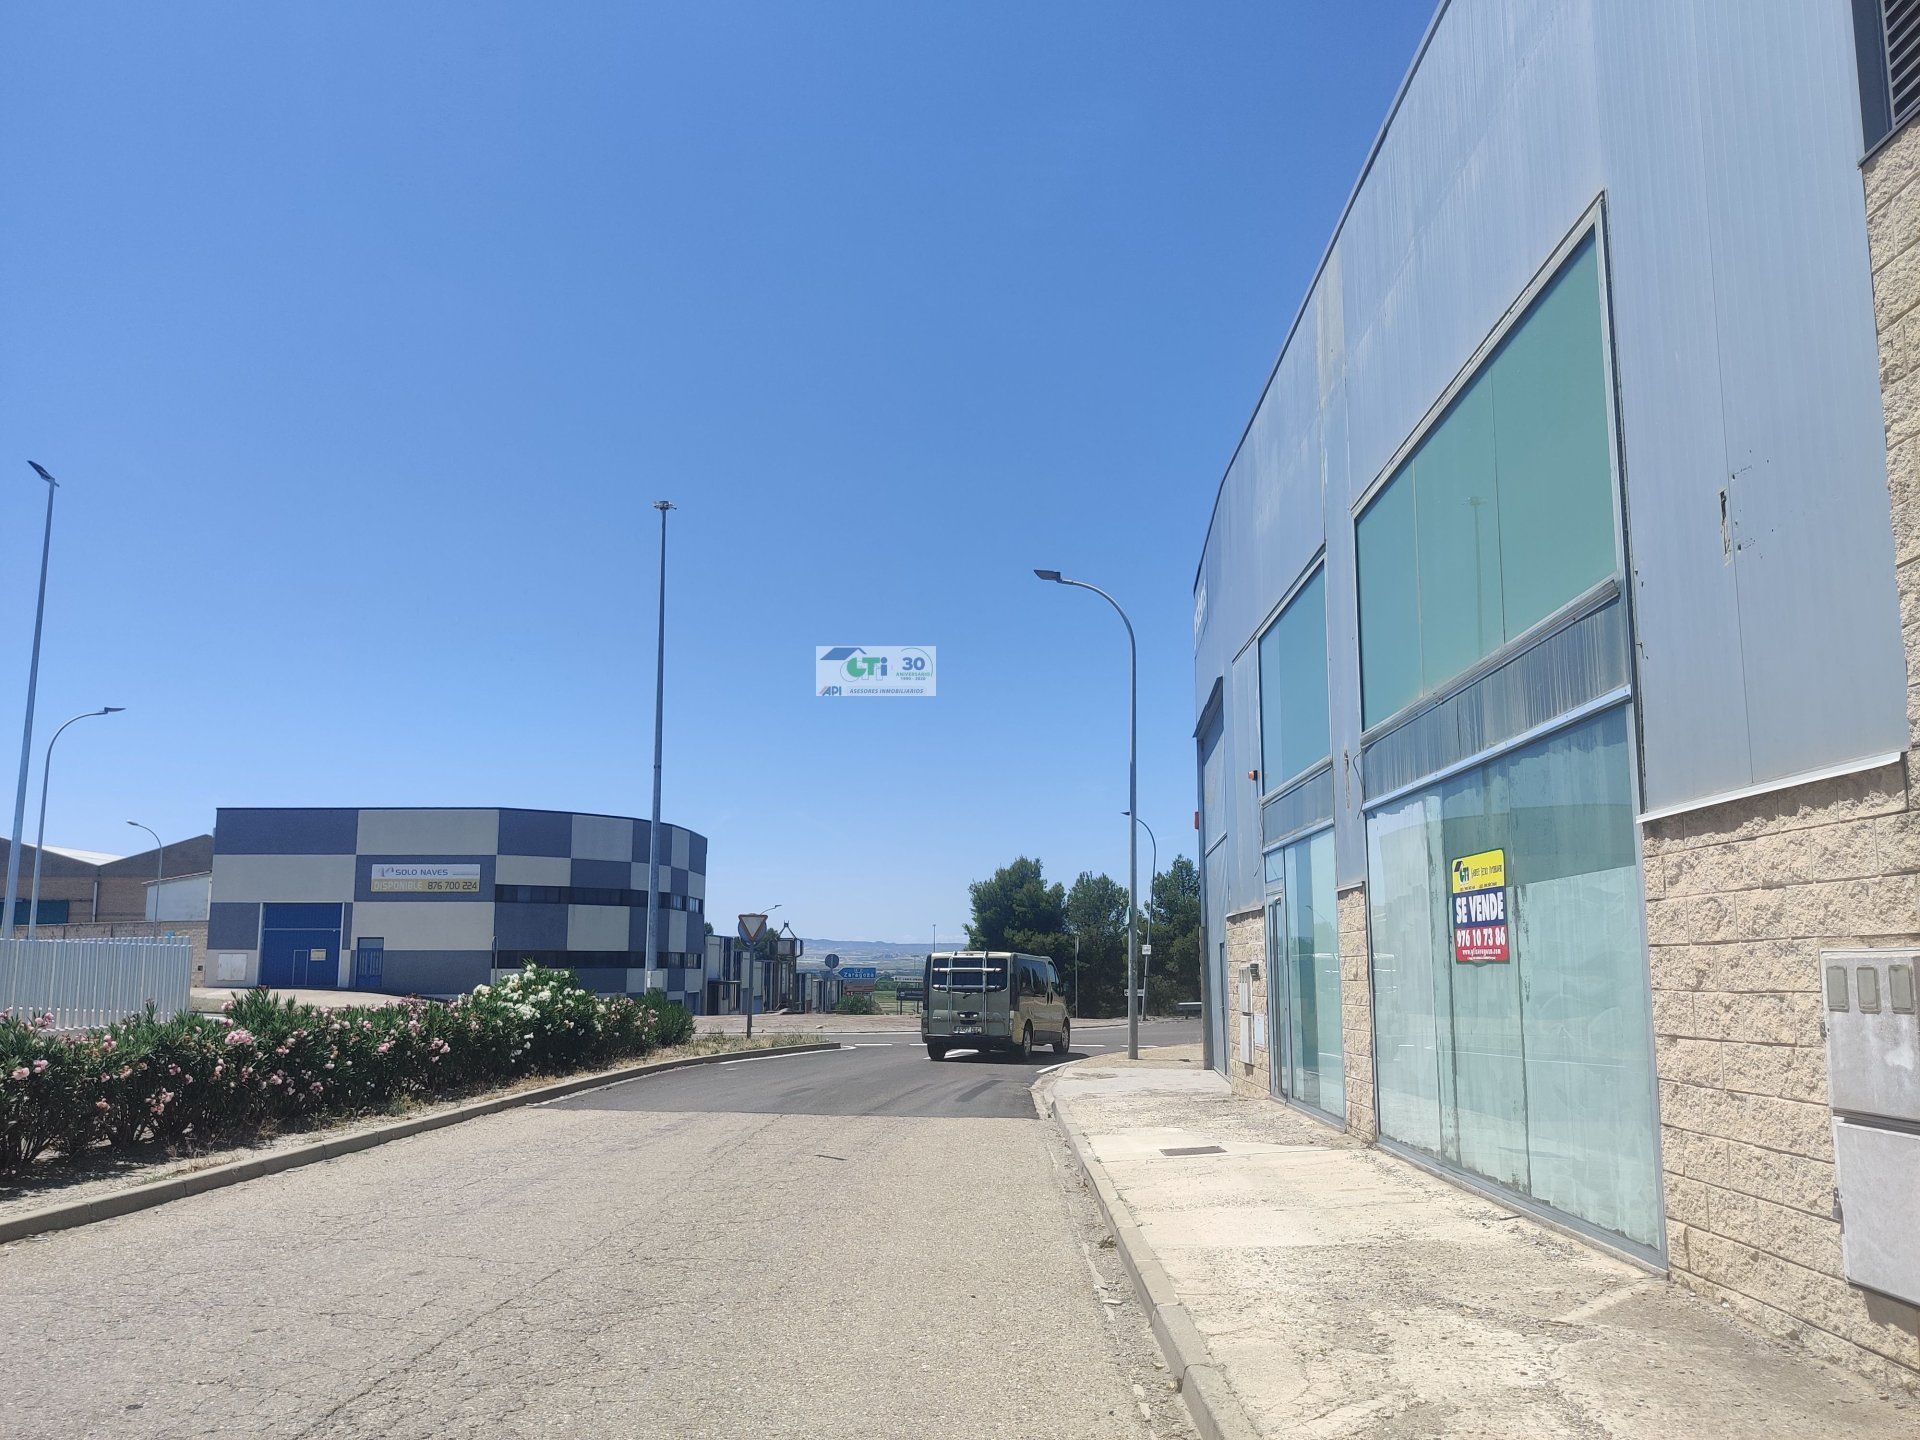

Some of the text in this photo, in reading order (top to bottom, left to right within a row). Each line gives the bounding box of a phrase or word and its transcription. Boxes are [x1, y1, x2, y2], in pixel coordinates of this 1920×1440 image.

[374, 881, 477, 890] DISPONIBLE 876 700 224
[1456, 892, 1504, 924] SE VENDE
[1456, 926, 1506, 948] 976 10 73 86
